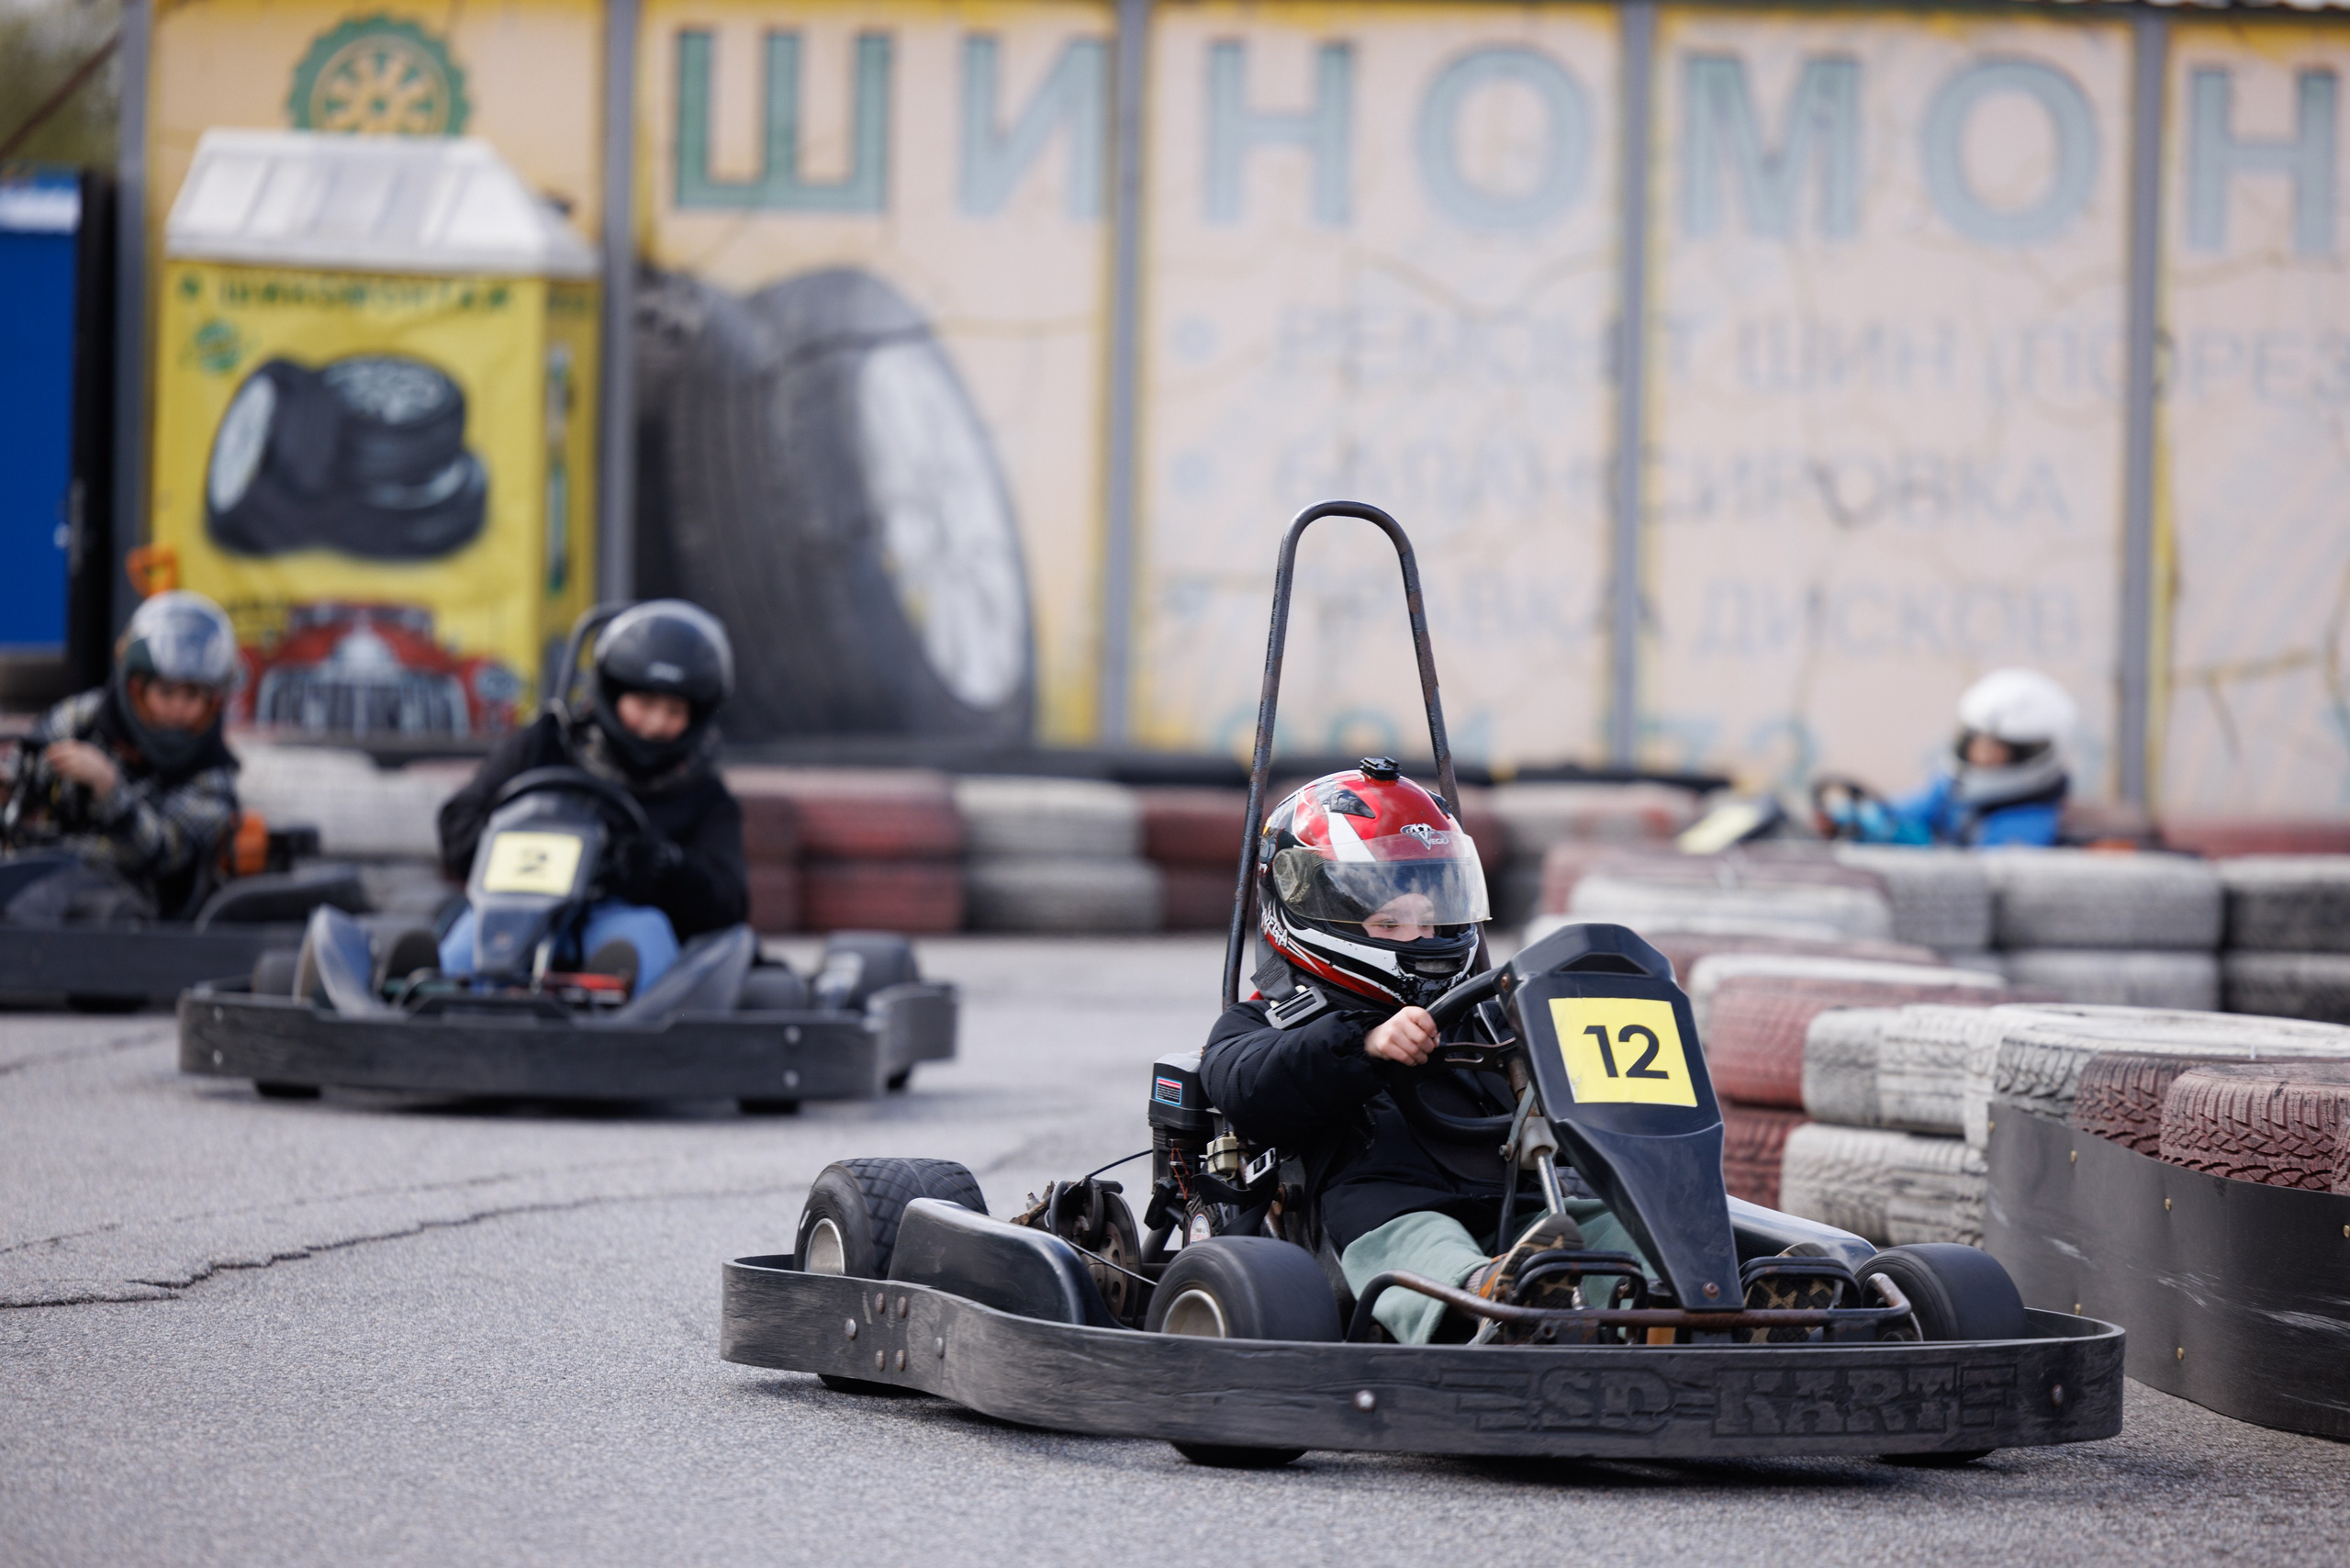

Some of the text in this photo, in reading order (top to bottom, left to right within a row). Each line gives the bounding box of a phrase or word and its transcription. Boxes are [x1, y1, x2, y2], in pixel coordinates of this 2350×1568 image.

[1736, 315, 1957, 395] ШИН
[1692, 581, 2084, 663] ДИСКОВ
[1583, 1024, 1670, 1080] 12
[1714, 1364, 1956, 1436] KART
